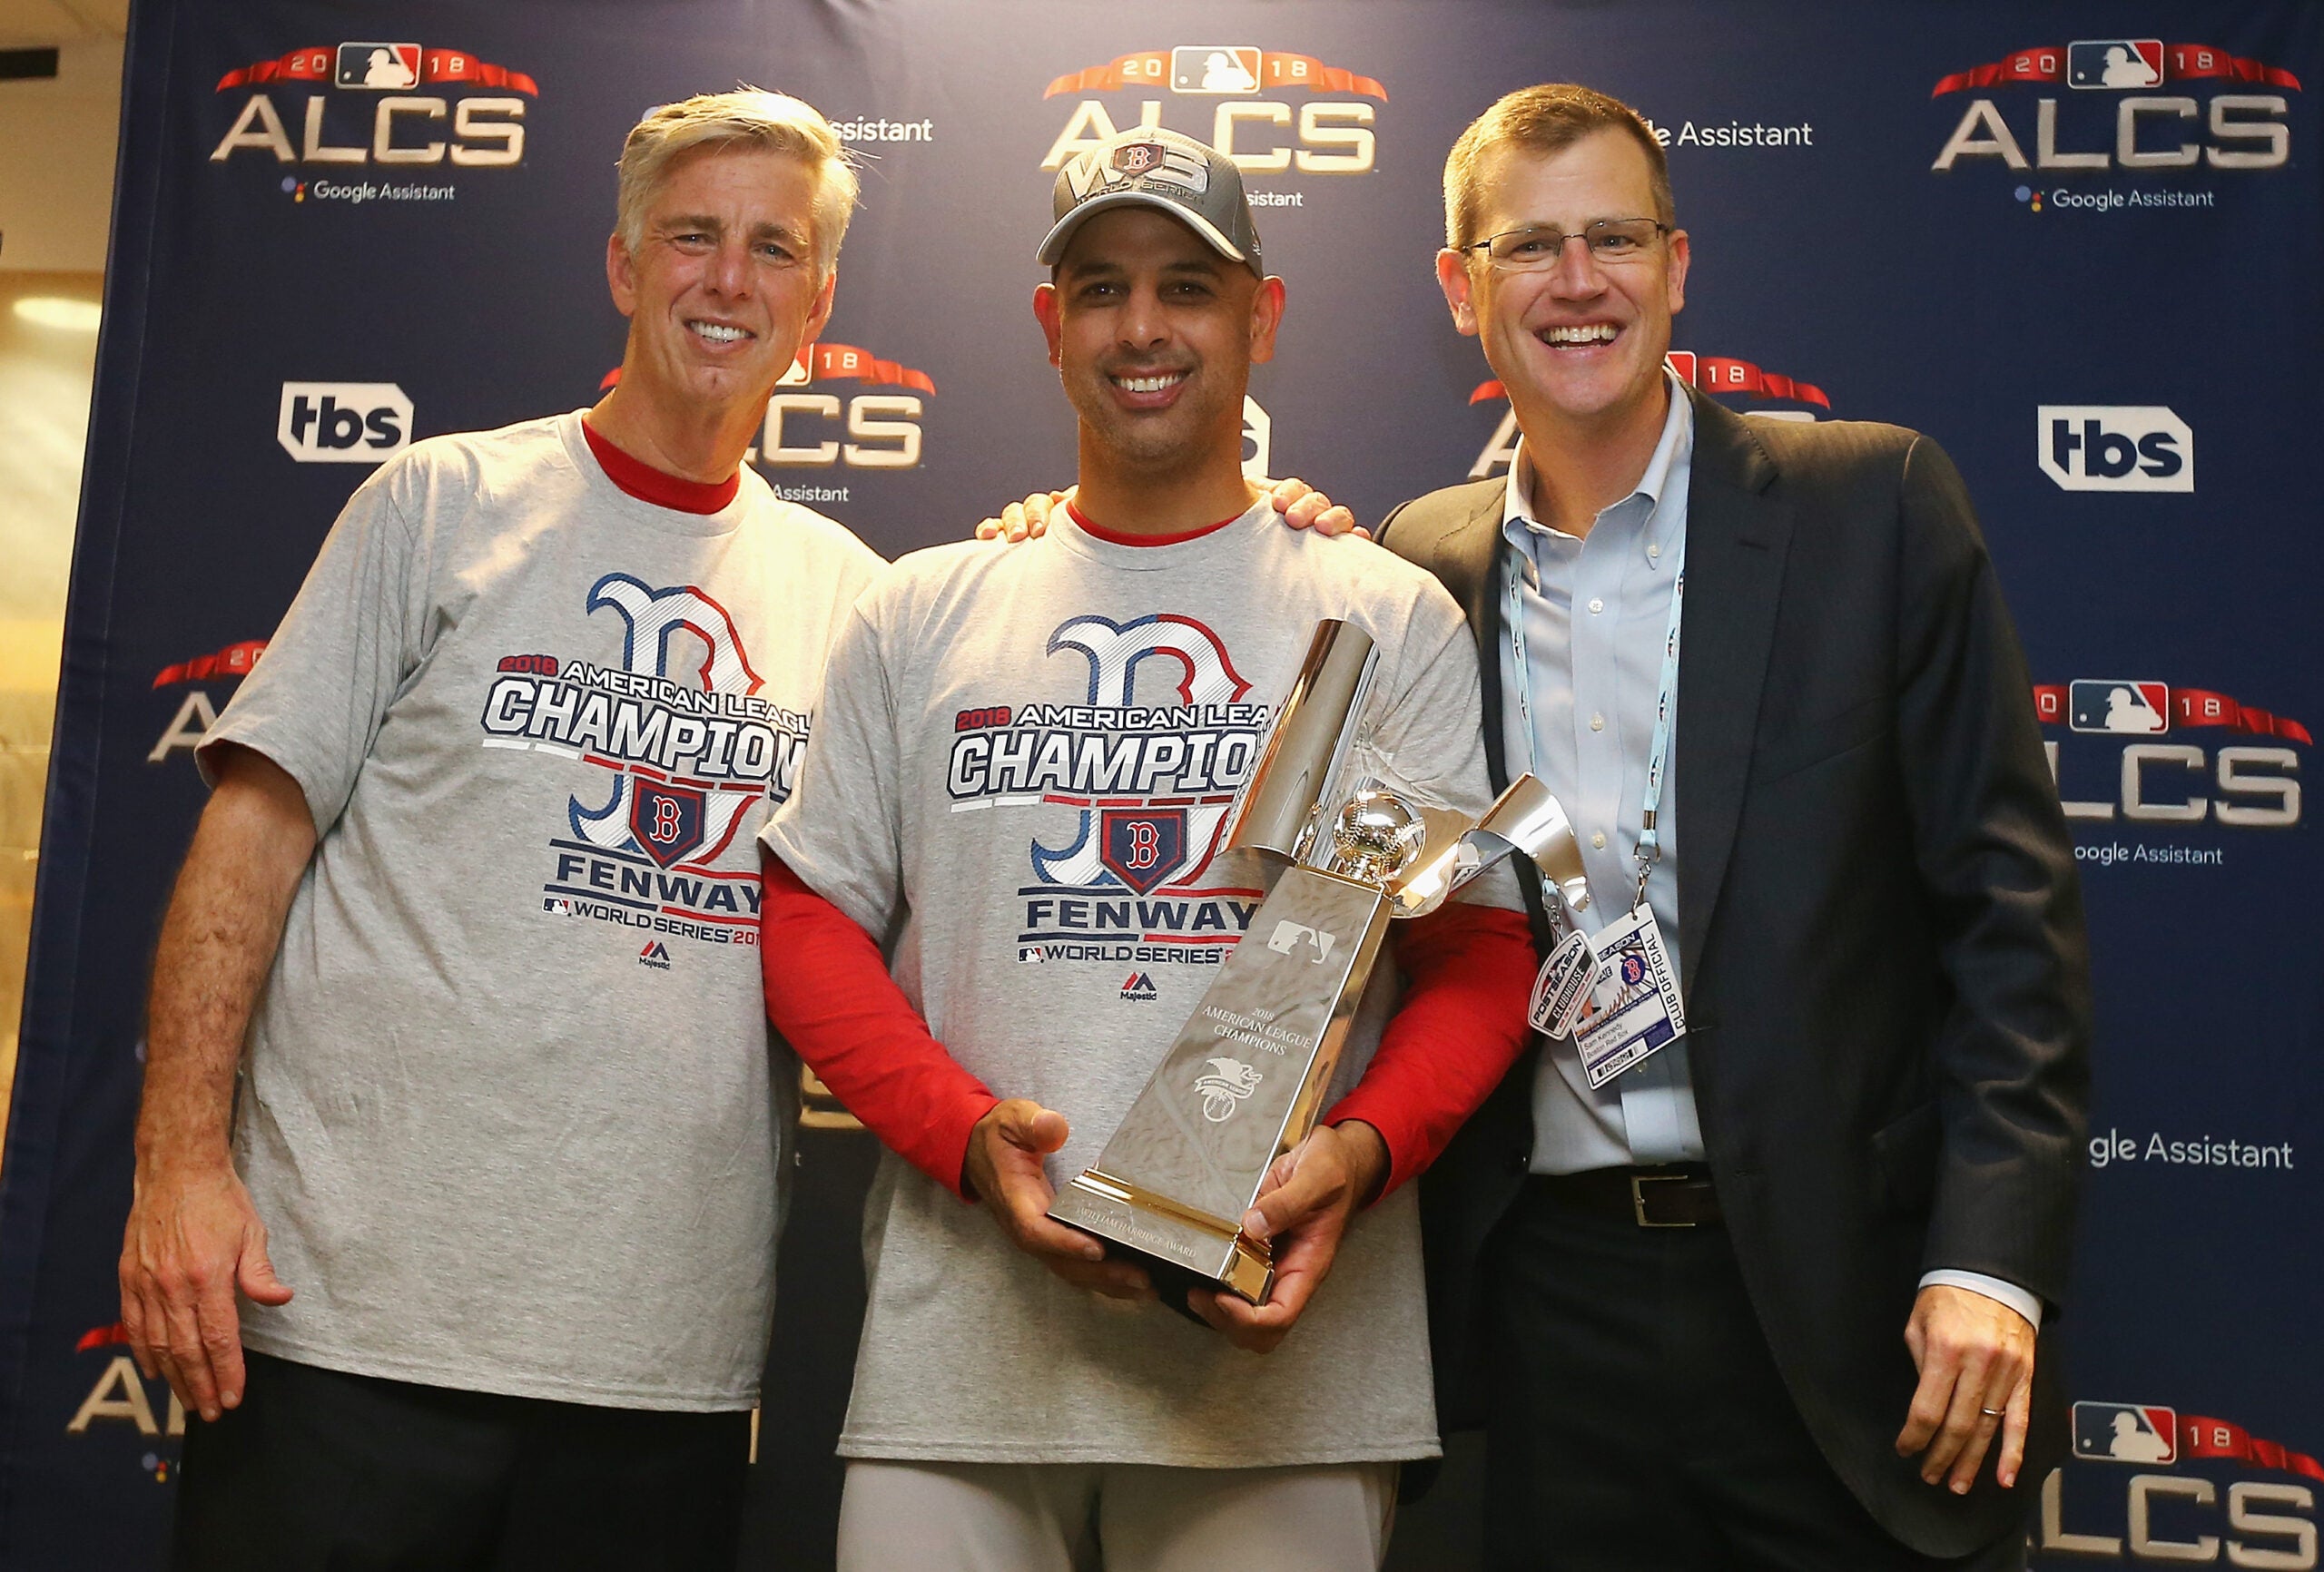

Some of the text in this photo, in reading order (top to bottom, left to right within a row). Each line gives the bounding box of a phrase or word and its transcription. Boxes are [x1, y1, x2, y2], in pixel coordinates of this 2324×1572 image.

[210, 94, 526, 165] ALCS
[829, 115, 933, 142] ssistant
[1039, 100, 1376, 172] ACS
[1678, 121, 1813, 146] Assistant
[1931, 94, 2290, 171] ALCS
[313, 182, 454, 201] Google Assistant
[1247, 190, 1303, 206] sistant
[2053, 188, 2214, 212] Google Assistant
[291, 396, 401, 448] tbs
[746, 394, 921, 466] CS
[2052, 419, 2182, 479] tbs
[773, 484, 849, 502] Assistant
[497, 654, 558, 676] 2018
[563, 661, 719, 712] AMERICAN
[481, 676, 807, 794] CHAMPION
[955, 703, 1269, 732] 2018 AMERICAN LEA
[947, 730, 1257, 799] CHAMPIO
[2043, 741, 2303, 826] LCS
[650, 795, 680, 843] B
[1125, 821, 1160, 870] B
[2074, 842, 2222, 866] oogle Assistant
[556, 853, 761, 914] FENWAY
[574, 900, 760, 946] WORLD SERIES 201
[638, 957, 671, 970] Majestic
[1045, 946, 1133, 961] WORLD
[1135, 948, 1219, 964] SERIES
[1120, 992, 1157, 1002] Majestic
[1533, 939, 1581, 1023] POSTSEASON
[1552, 967, 1585, 1018] CLUBHOUSE
[1647, 934, 1686, 1030] CLUB OFFICIAL
[1202, 1005, 1313, 1048] AMERICAN LEAGUE
[1252, 1007, 1275, 1021] 2018
[1214, 1024, 1287, 1056] CHAMPIONS
[1584, 1037, 1598, 1050] Sam
[2090, 1128, 2293, 1168] gle Assistant
[2041, 1468, 2317, 1568] LCS
